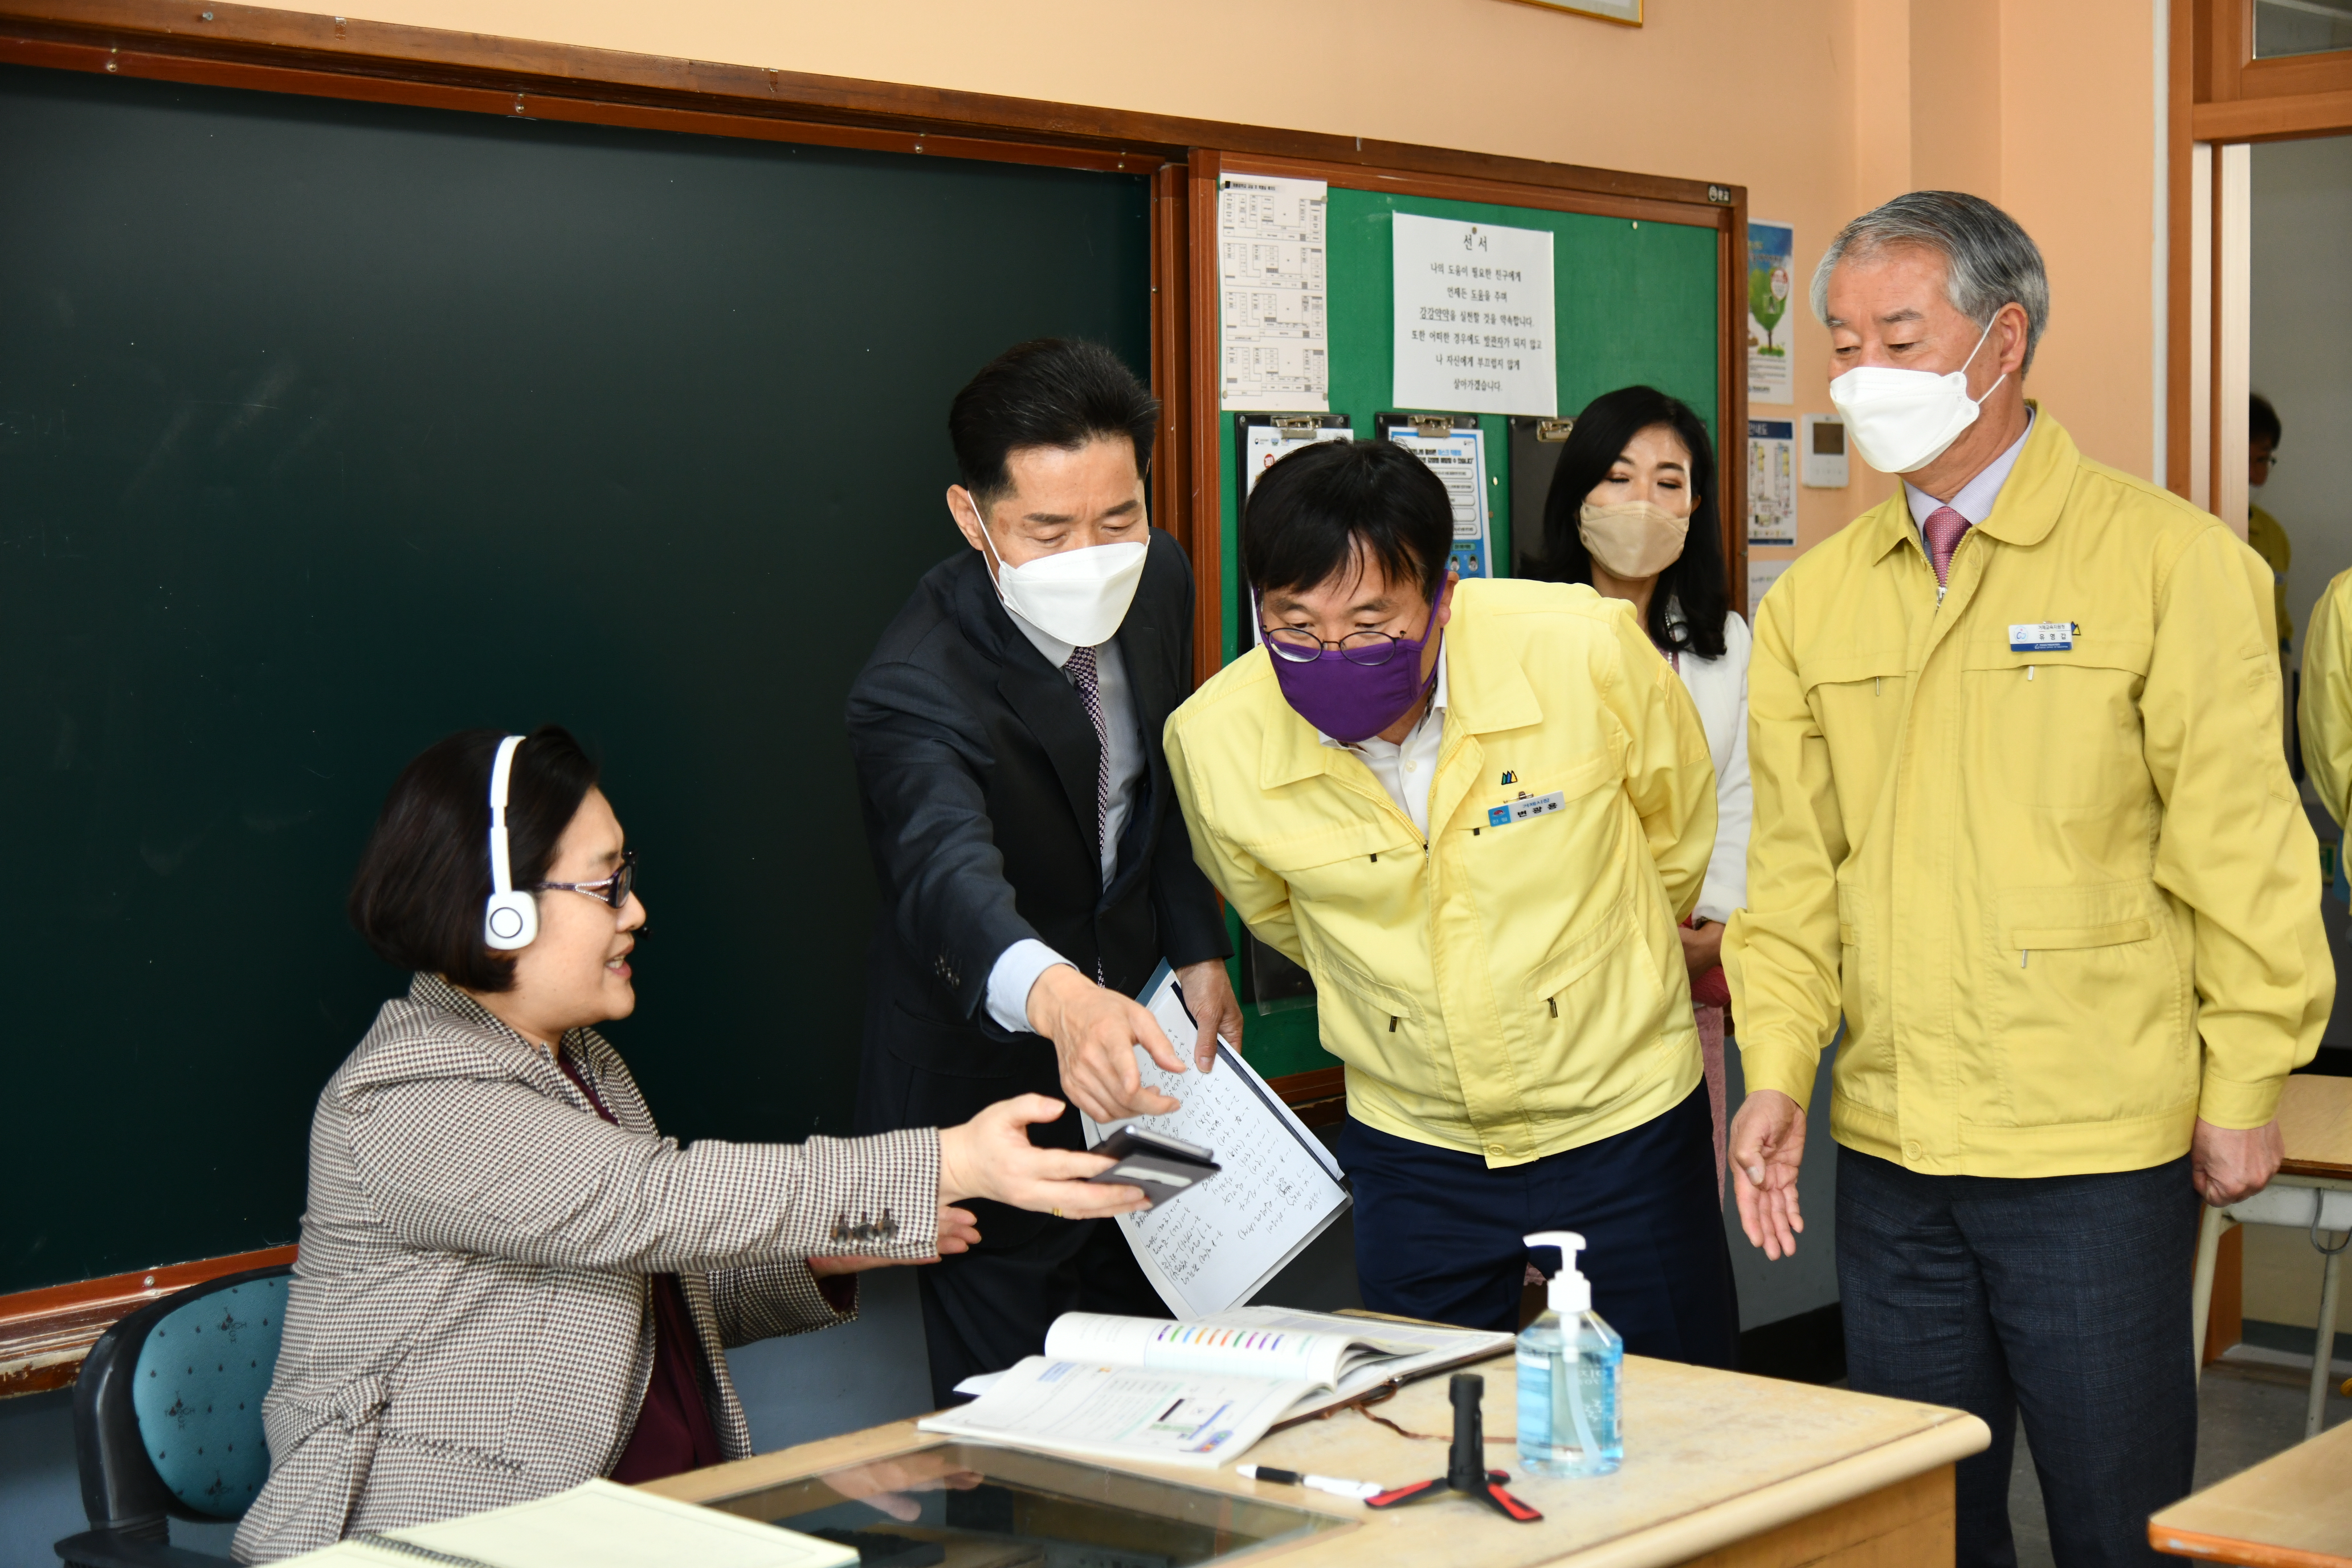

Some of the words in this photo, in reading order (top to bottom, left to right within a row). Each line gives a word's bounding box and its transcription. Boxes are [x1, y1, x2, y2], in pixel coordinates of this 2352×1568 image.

[1431, 263, 1444, 274] 나의
[1448, 265, 1468, 276] 도움이
[1472, 267, 1491, 279] 필요한
[1496, 269, 1521, 282] 친구에게
[1447, 287, 1467, 299] 언제든
[1471, 289, 1490, 301] 도움을
[1495, 291, 1507, 303] 주며
[1484, 313, 1496, 324] 것을
[1500, 315, 1534, 327] 약속합니다.
[1412, 330, 1425, 341] 또한
[1430, 331, 1449, 343] 어떠한
[1454, 333, 1480, 345] 경우에도
[1484, 336, 1510, 348] 방관자가
[1513, 338, 1526, 349] 되지
[1436, 354, 1443, 365] 나
[1447, 354, 1473, 367] 자신에게
[1477, 357, 1504, 369] 부끄럽지
[1453, 378, 1502, 392] 살아가겠습니다.
[1523, 798, 1549, 808] 거제시장
